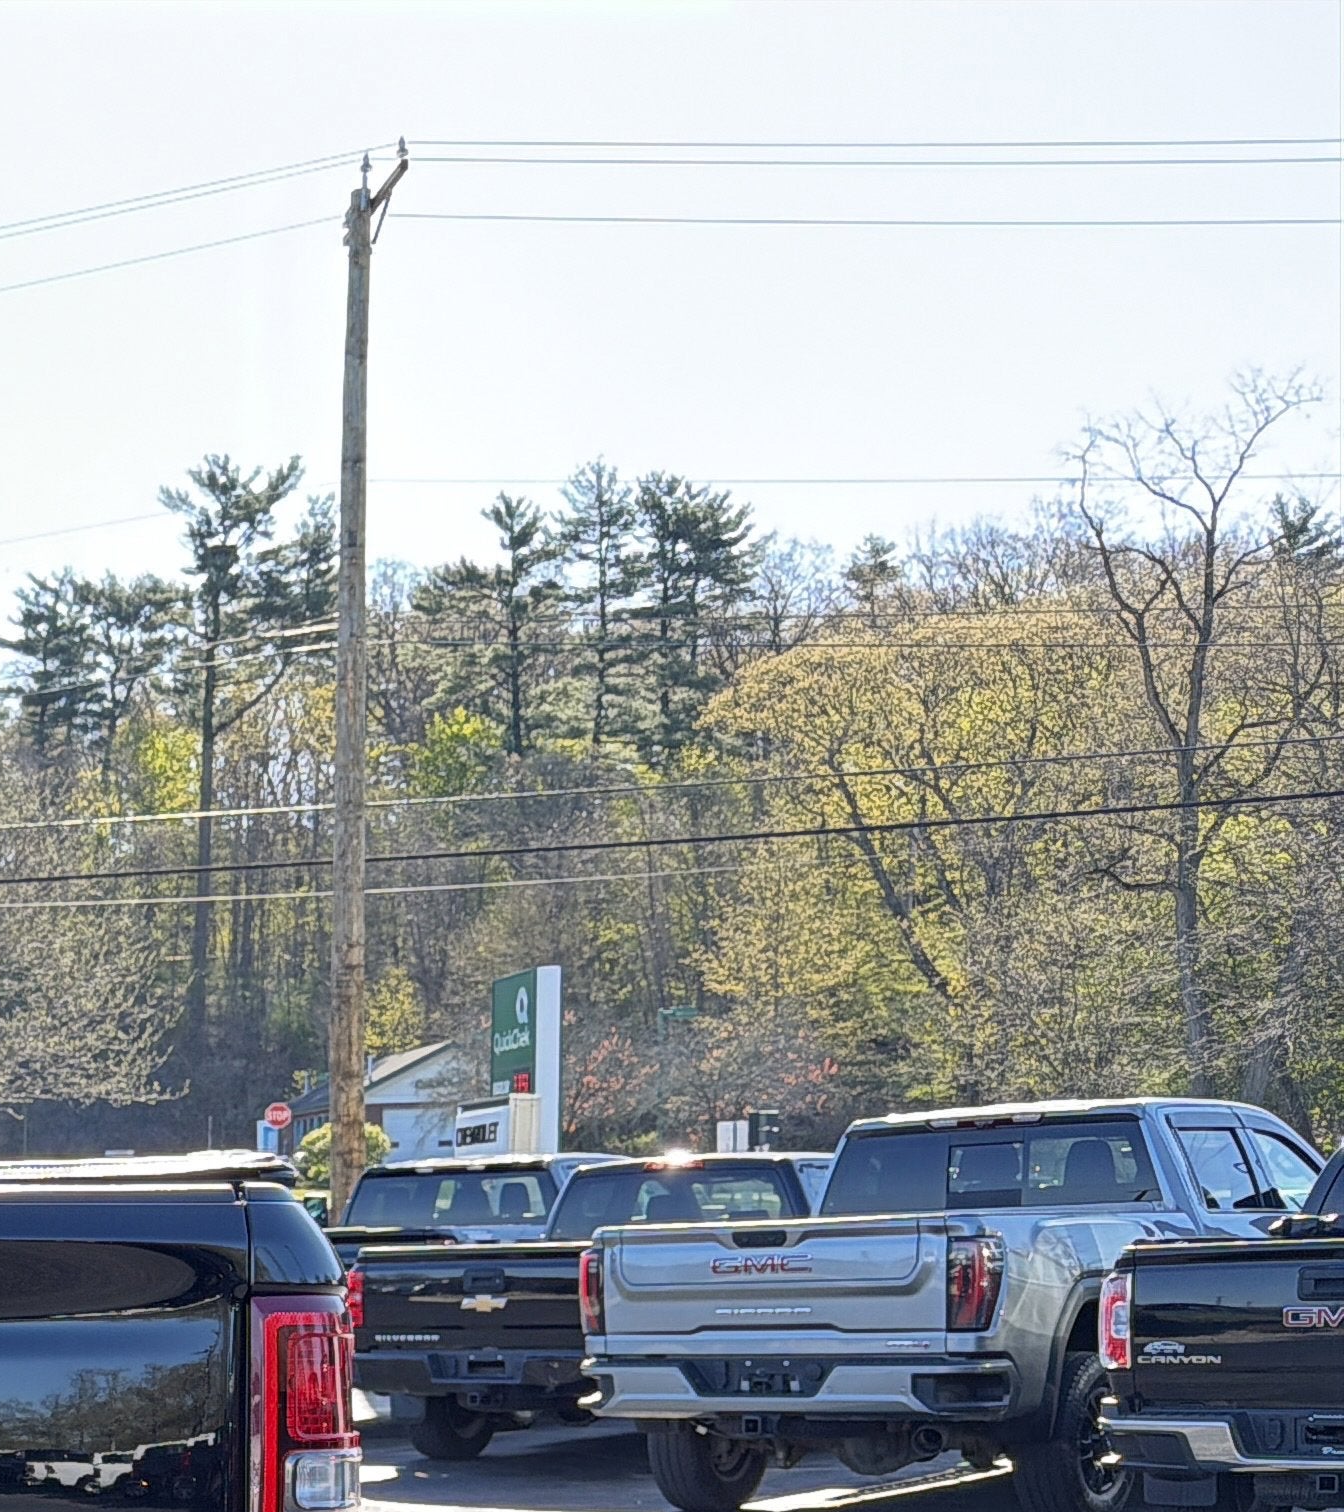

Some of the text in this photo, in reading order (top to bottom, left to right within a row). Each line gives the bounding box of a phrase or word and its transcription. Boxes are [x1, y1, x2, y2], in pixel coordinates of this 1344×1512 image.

[266, 1110, 289, 1121] STOP
[711, 1254, 812, 1274] GMC
[1137, 1355, 1222, 1364] CANYON
